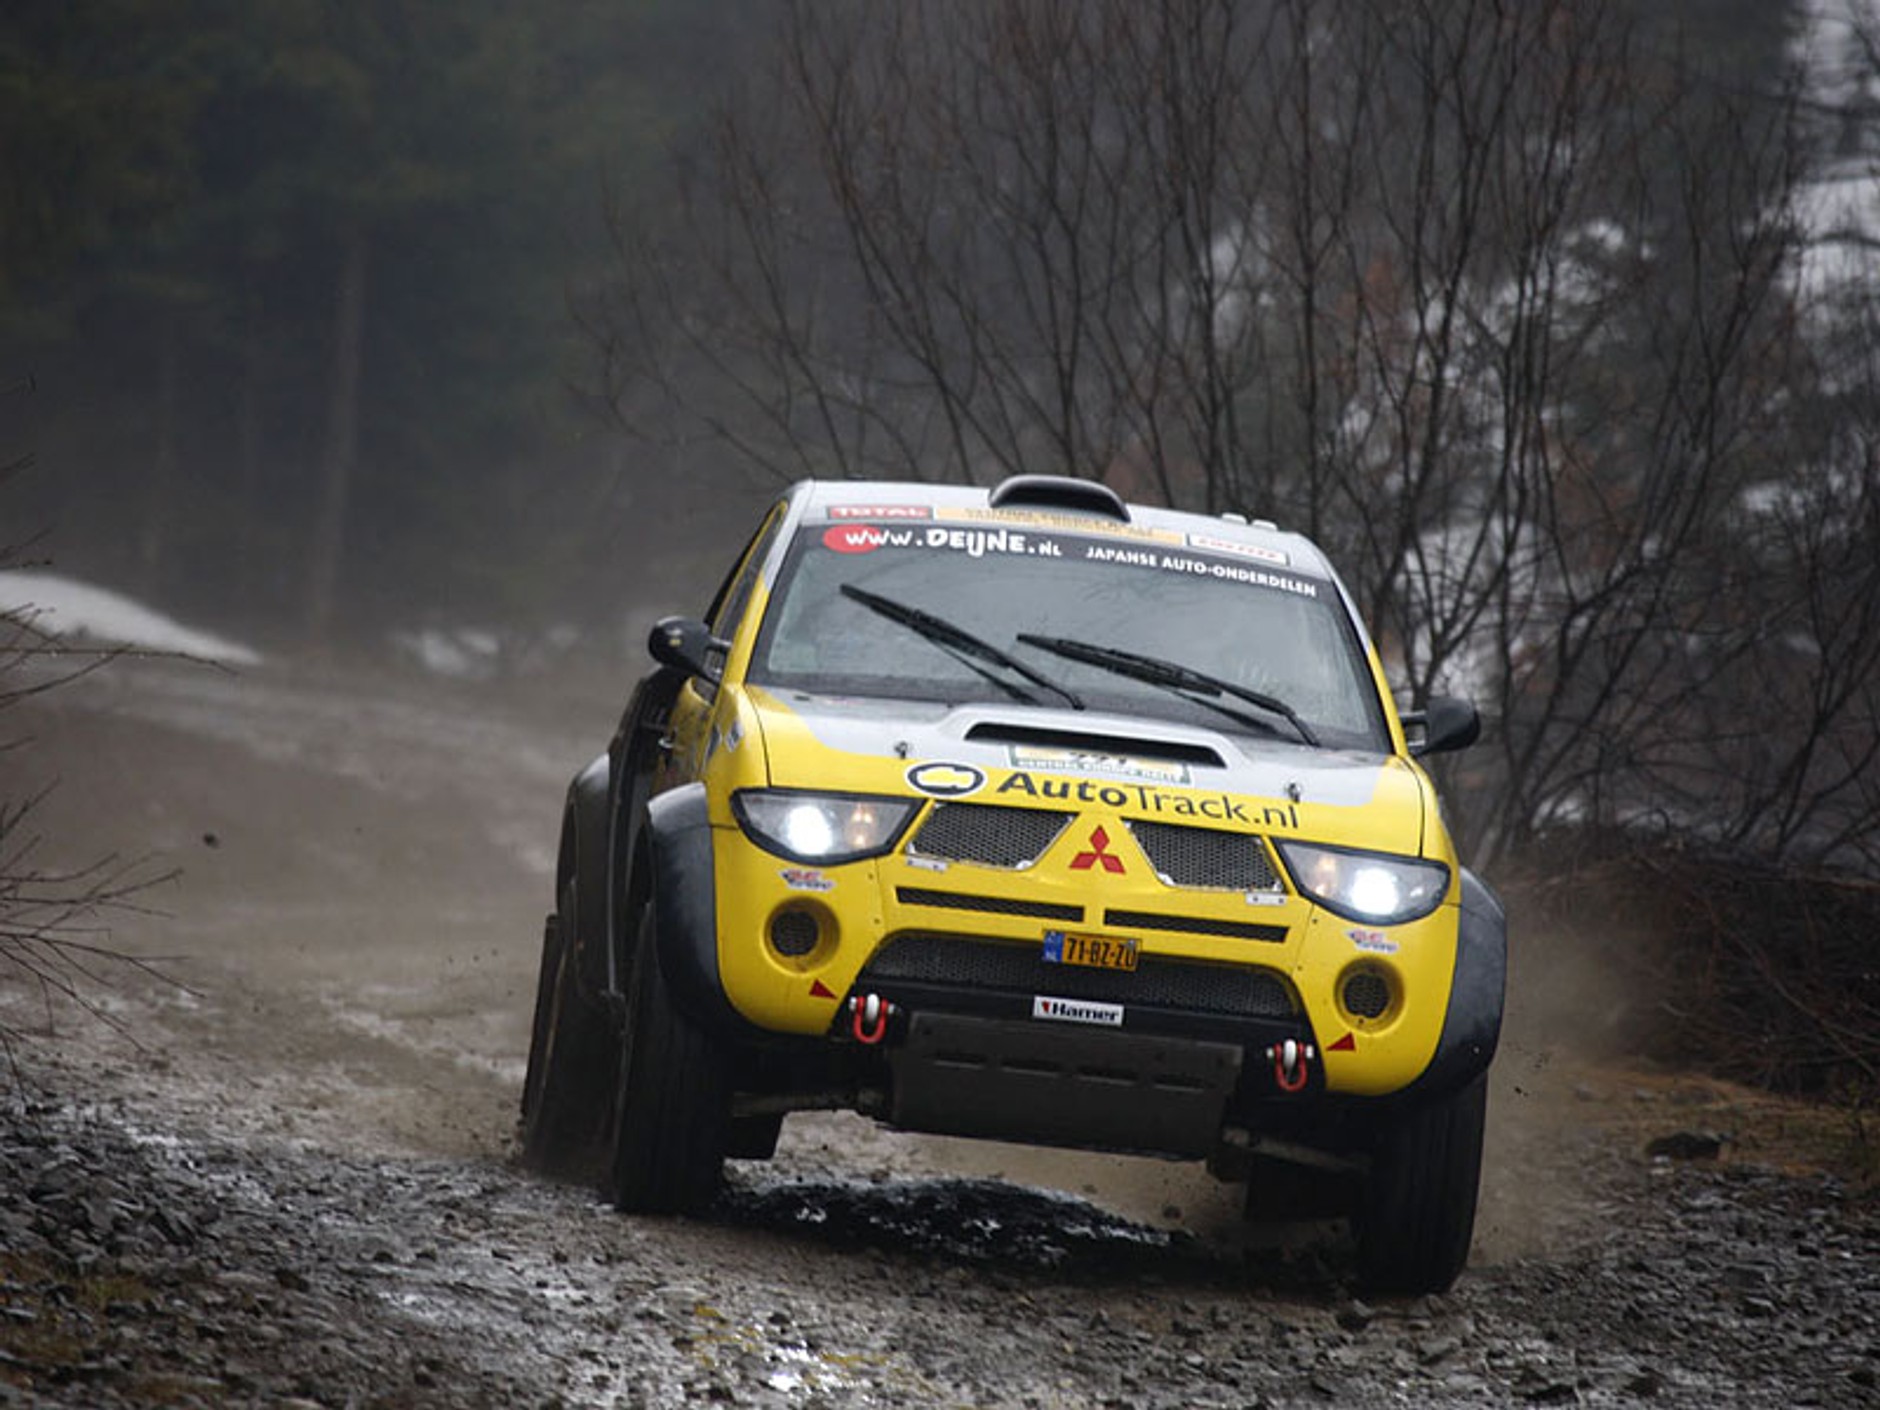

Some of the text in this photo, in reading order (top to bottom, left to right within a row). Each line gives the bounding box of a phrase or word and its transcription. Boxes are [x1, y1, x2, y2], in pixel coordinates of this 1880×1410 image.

[833, 506, 928, 518] TOTAL
[1086, 546, 1317, 598] JAPANSE AUTO-ONDERDELEN
[997, 771, 1299, 829] AutoTrack.nl
